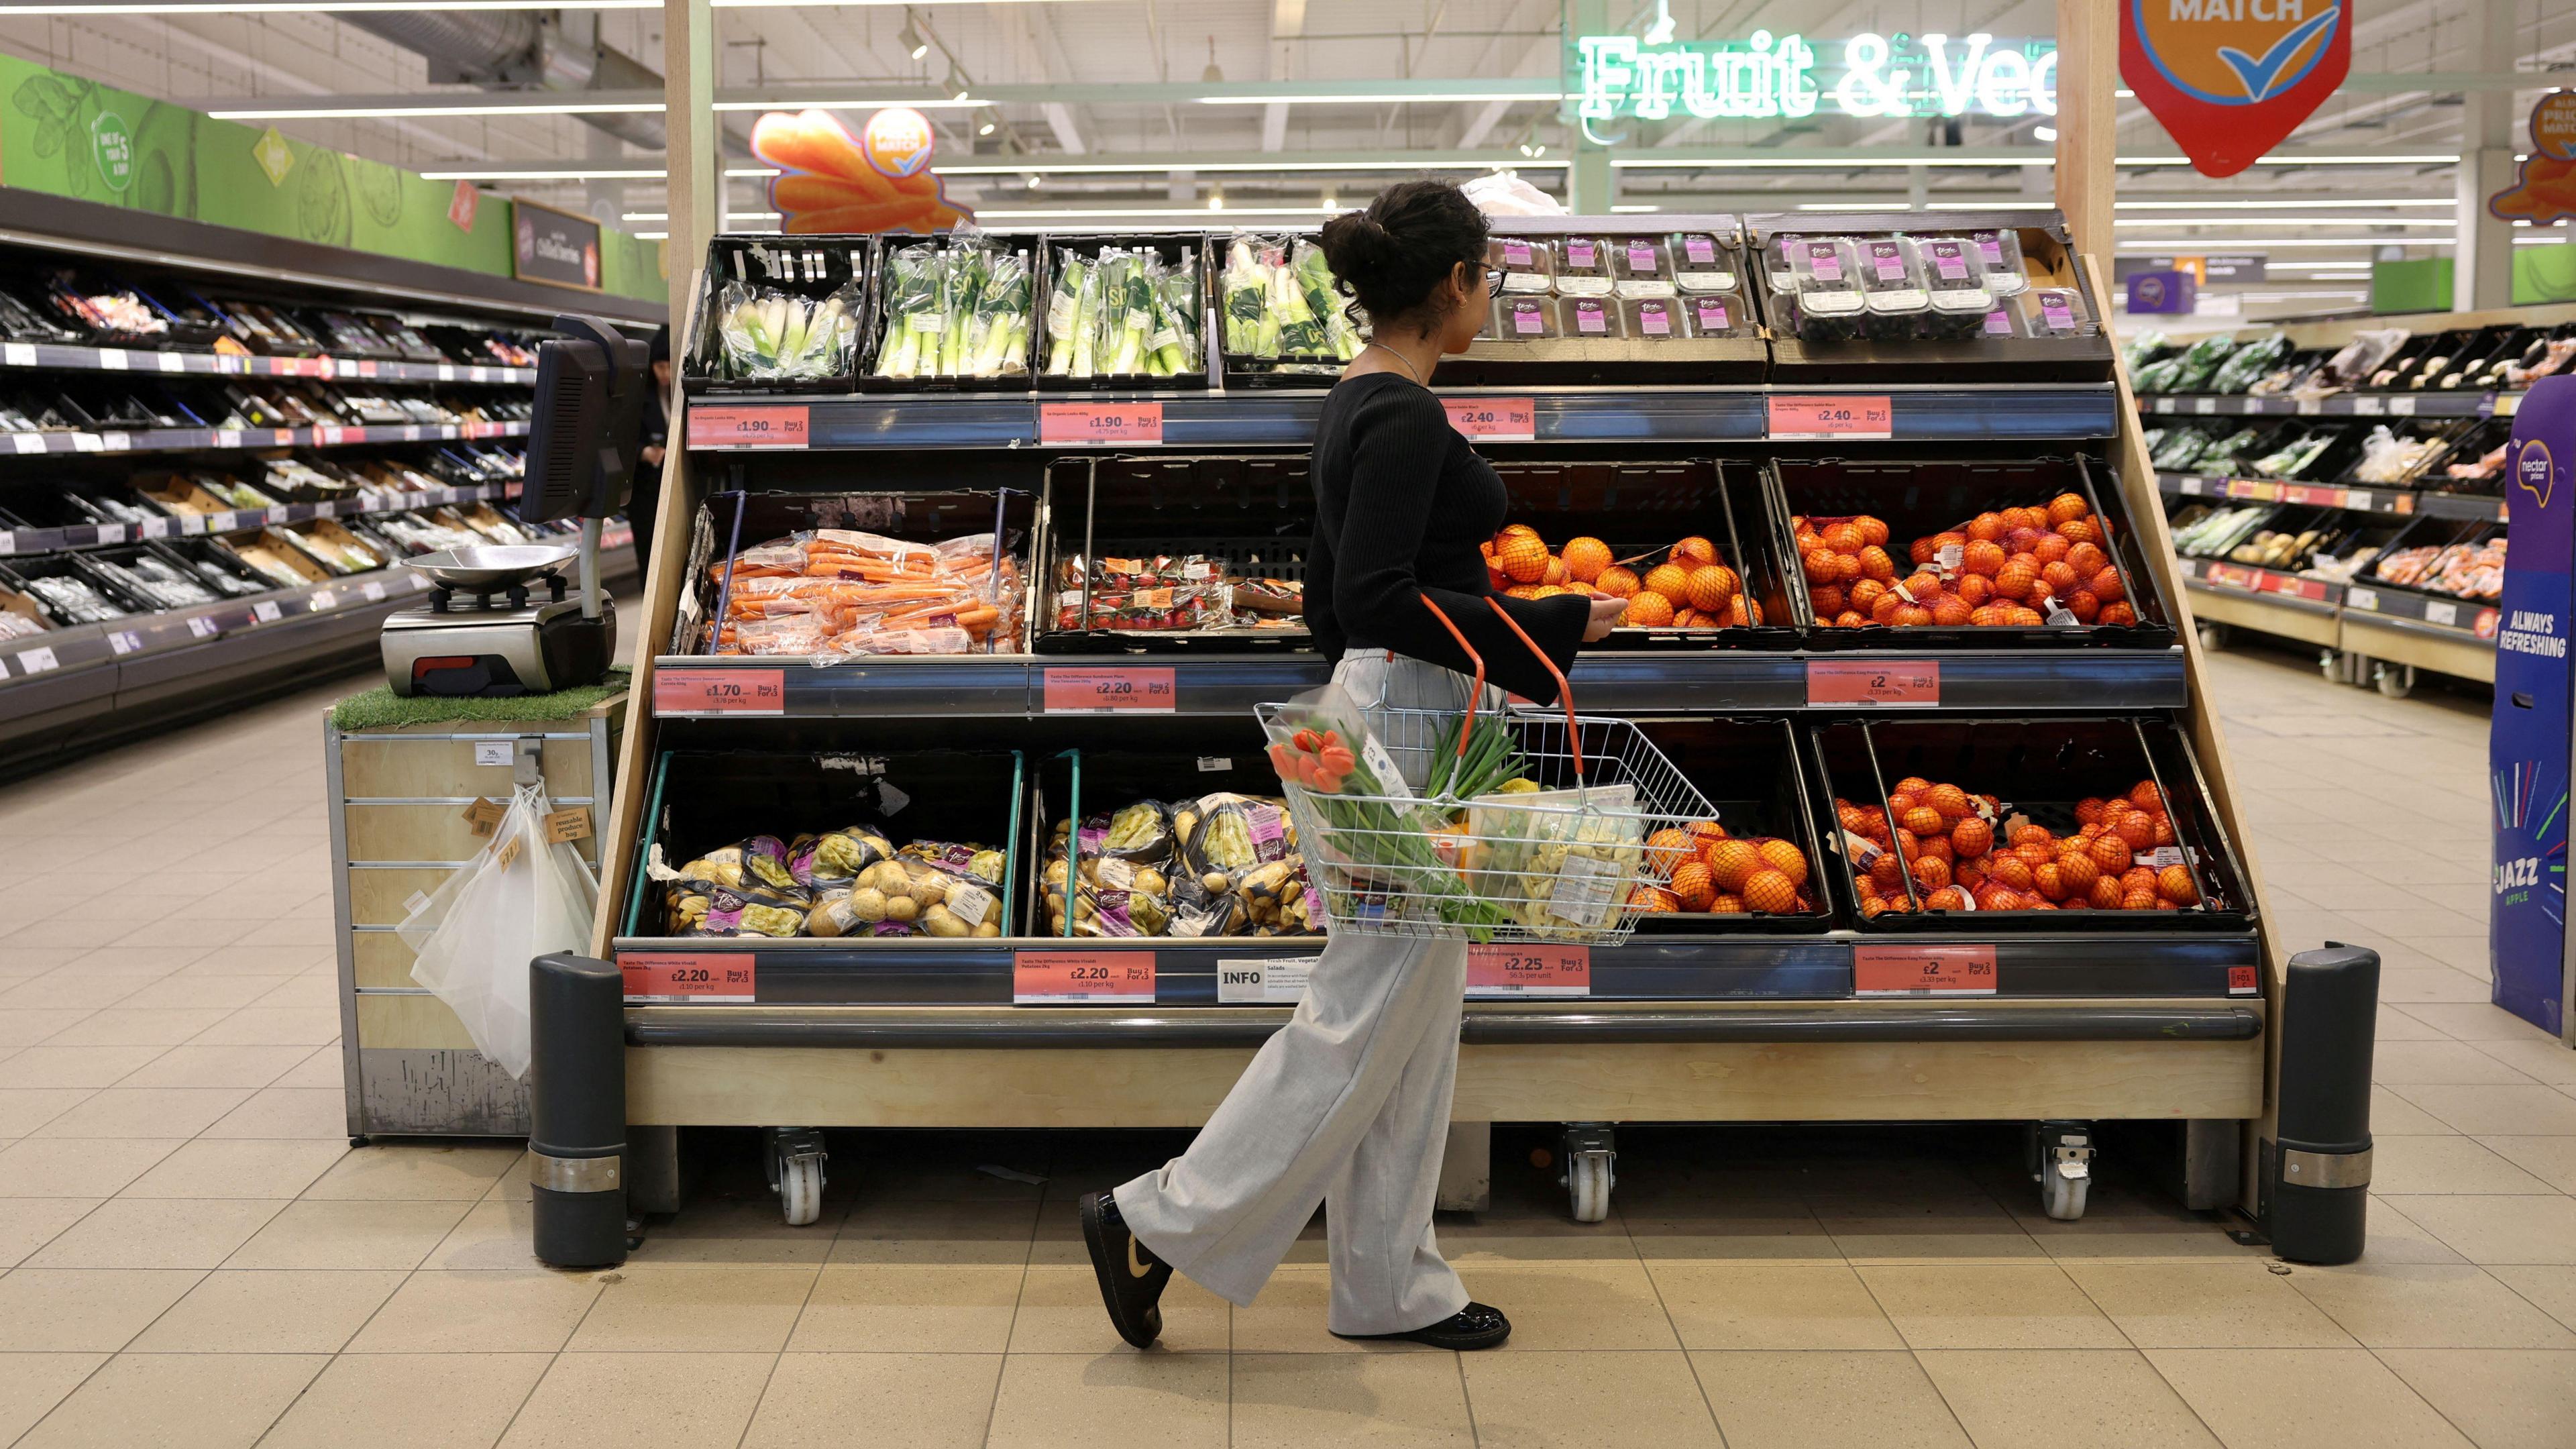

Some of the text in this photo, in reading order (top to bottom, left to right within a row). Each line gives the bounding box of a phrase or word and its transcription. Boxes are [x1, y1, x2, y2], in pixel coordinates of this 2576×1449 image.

[2169, 0, 2302, 21] MATCH
[1578, 30, 1818, 119] Fruit
[1837, 33, 1913, 117] &
[120, 136, 129, 160] 5
[1461, 413, 1494, 423] £2.40
[1818, 410, 1851, 421] £2.40
[737, 421, 769, 431] £1.90
[1089, 417, 1122, 427] £1.90
[2522, 460, 2548, 472] nectar
[2530, 473, 2544, 481] prices
[2510, 610, 2554, 635] ALWAYS
[2499, 629, 2567, 659] REFRESHING
[1096, 682, 1132, 694] £2.20
[1871, 676, 1886, 688] £2
[706, 684, 741, 696] £1.70
[555, 816, 583, 826] reusable
[557, 824, 583, 834] produce
[2495, 857, 2538, 894] JAZZ
[2505, 891, 2528, 906] APPLE
[1505, 958, 1543, 970] £2.25
[1923, 962, 1939, 974] £2
[672, 969, 708, 981] £2.20
[1071, 968, 1108, 979] £2.20
[1224, 972, 1260, 984] INFO
